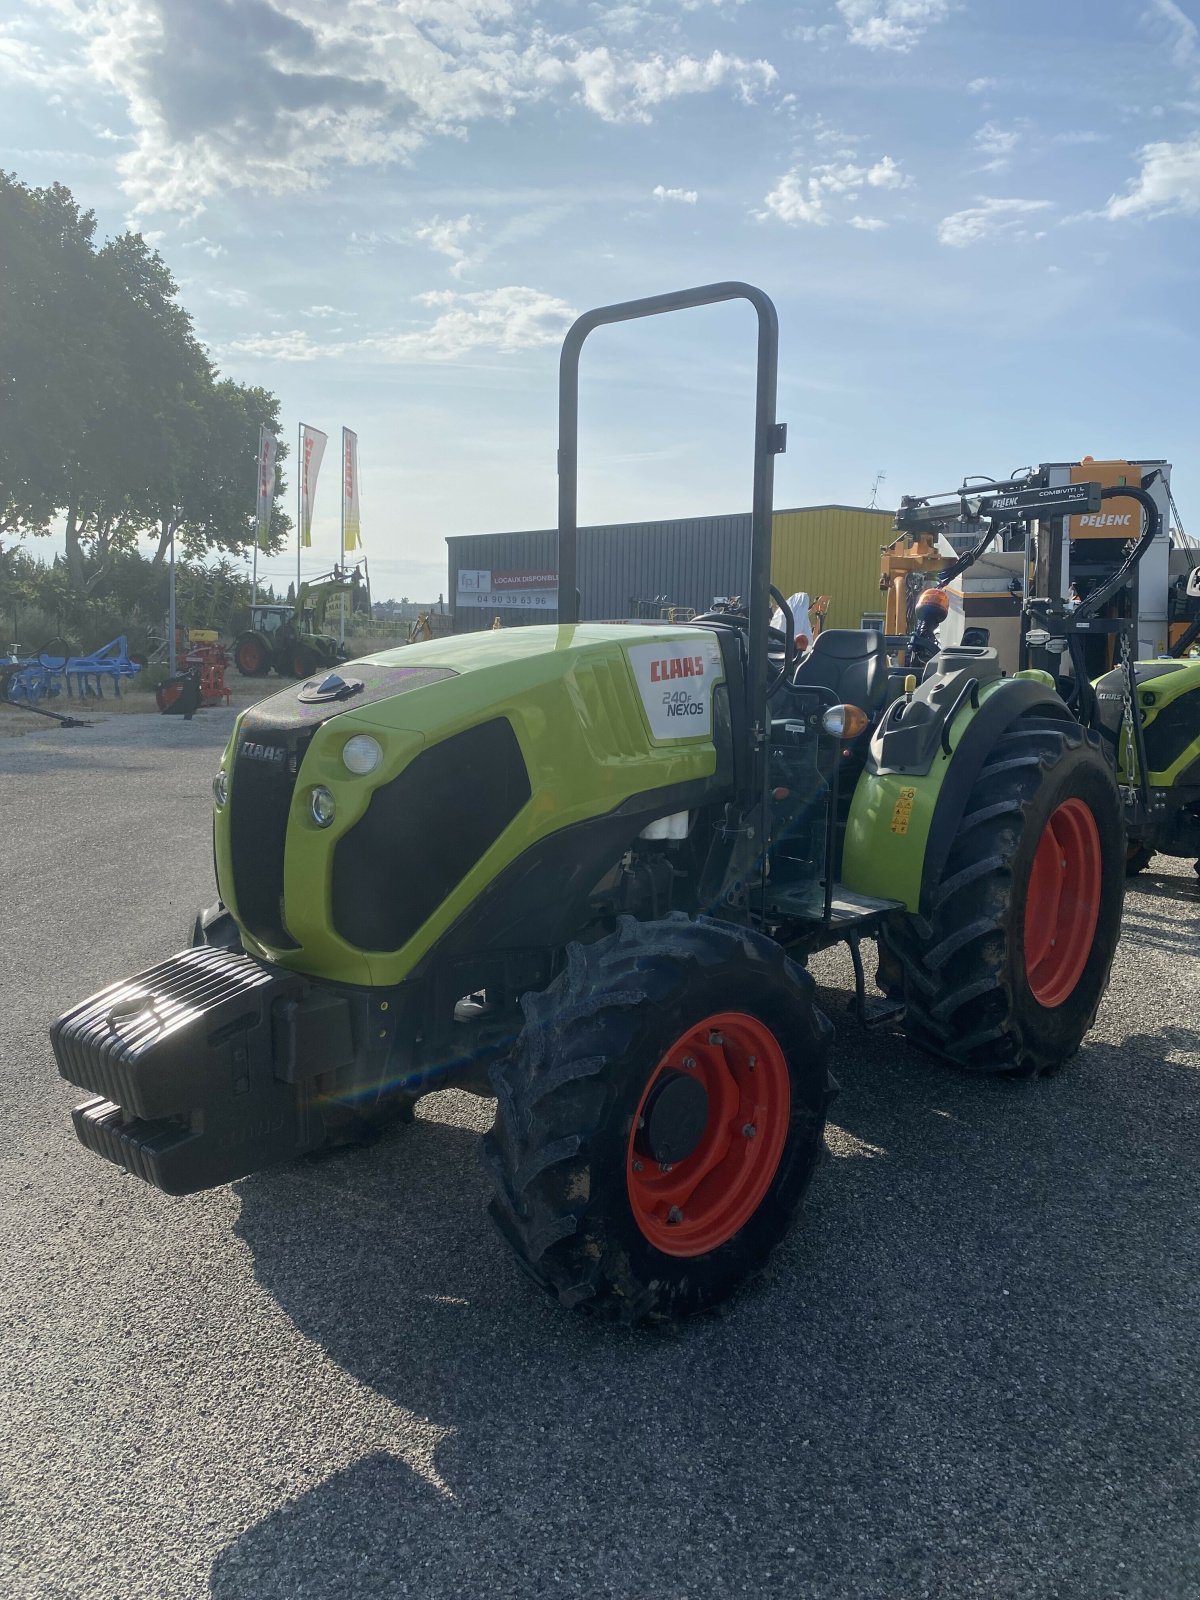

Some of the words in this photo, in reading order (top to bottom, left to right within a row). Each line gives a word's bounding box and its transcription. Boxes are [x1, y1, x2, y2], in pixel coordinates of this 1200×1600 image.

[1038, 487, 1077, 497] COMBIVITI
[992, 496, 1019, 508] PELLENC
[1080, 514, 1132, 528] PELLENC
[477, 595, 489, 604] 04
[491, 595, 503, 604] 90
[535, 597, 546, 605] 96
[650, 656, 704, 682] CLAAS
[667, 703, 704, 716] NEXOS
